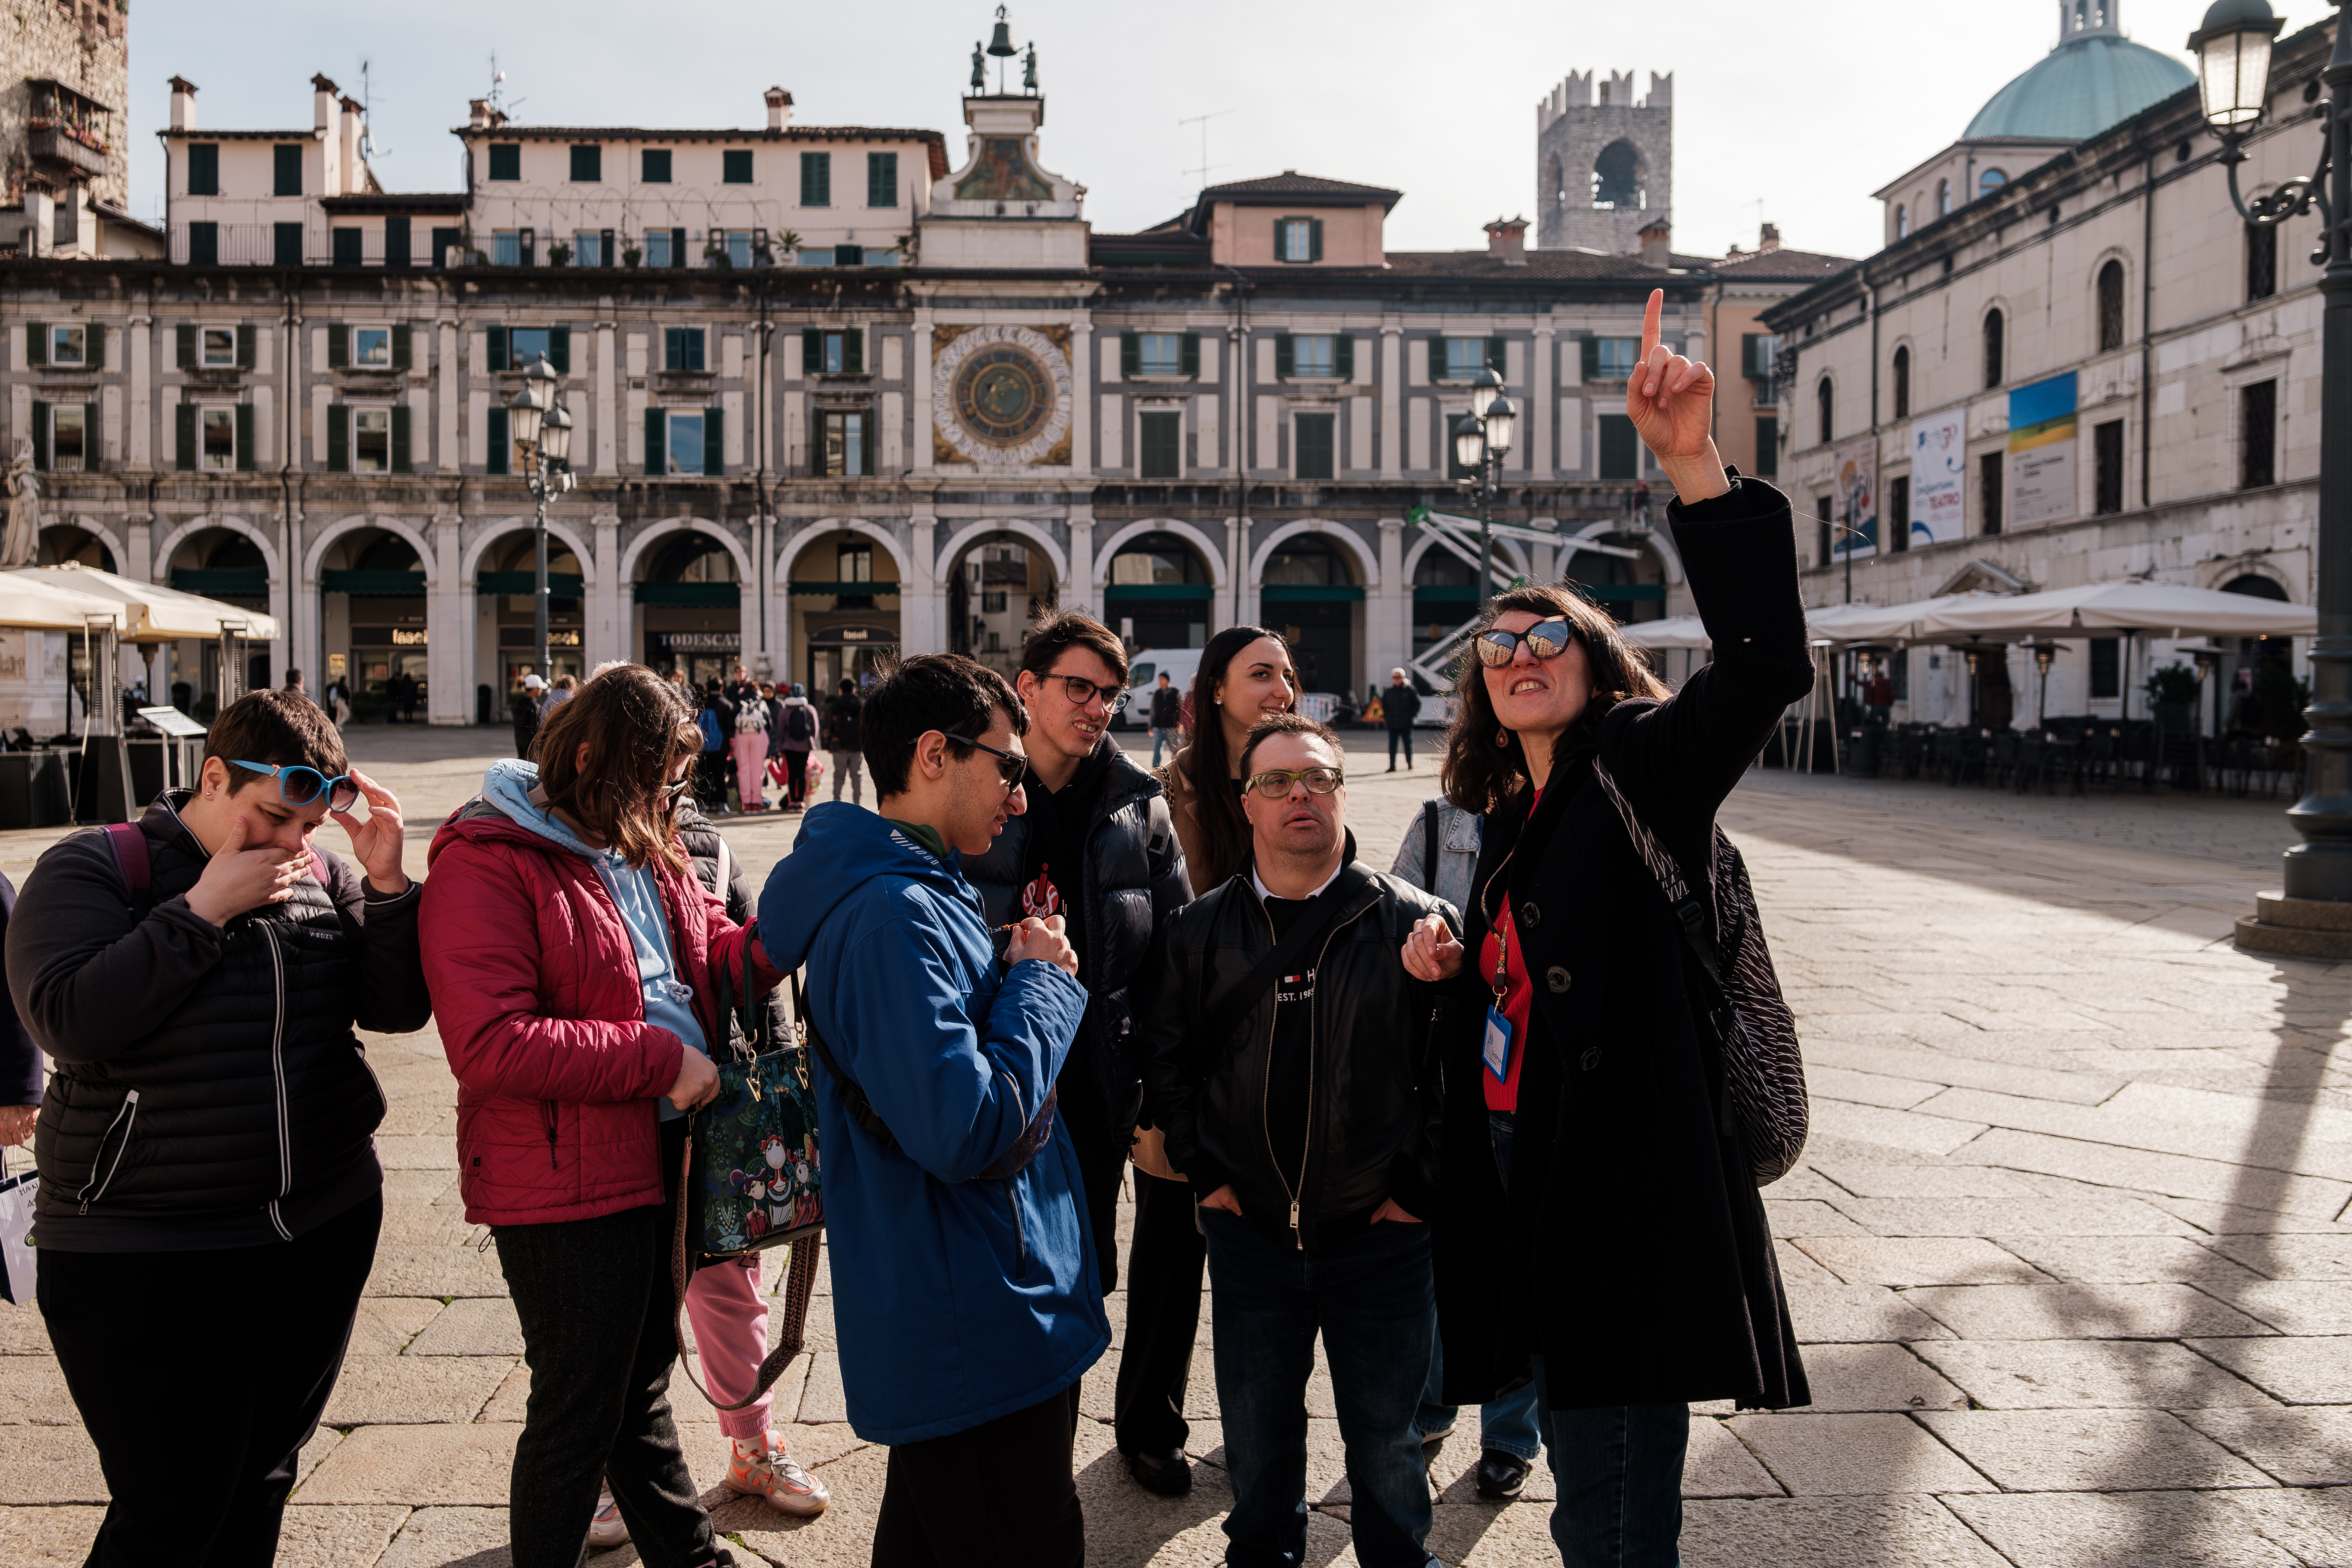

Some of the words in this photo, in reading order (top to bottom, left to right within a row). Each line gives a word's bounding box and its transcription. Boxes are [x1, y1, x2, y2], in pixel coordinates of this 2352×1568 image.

[1023, 882, 1058, 918] STAFF
[309, 931, 333, 940] WEDZE
[1278, 993, 1296, 1001] EST.
